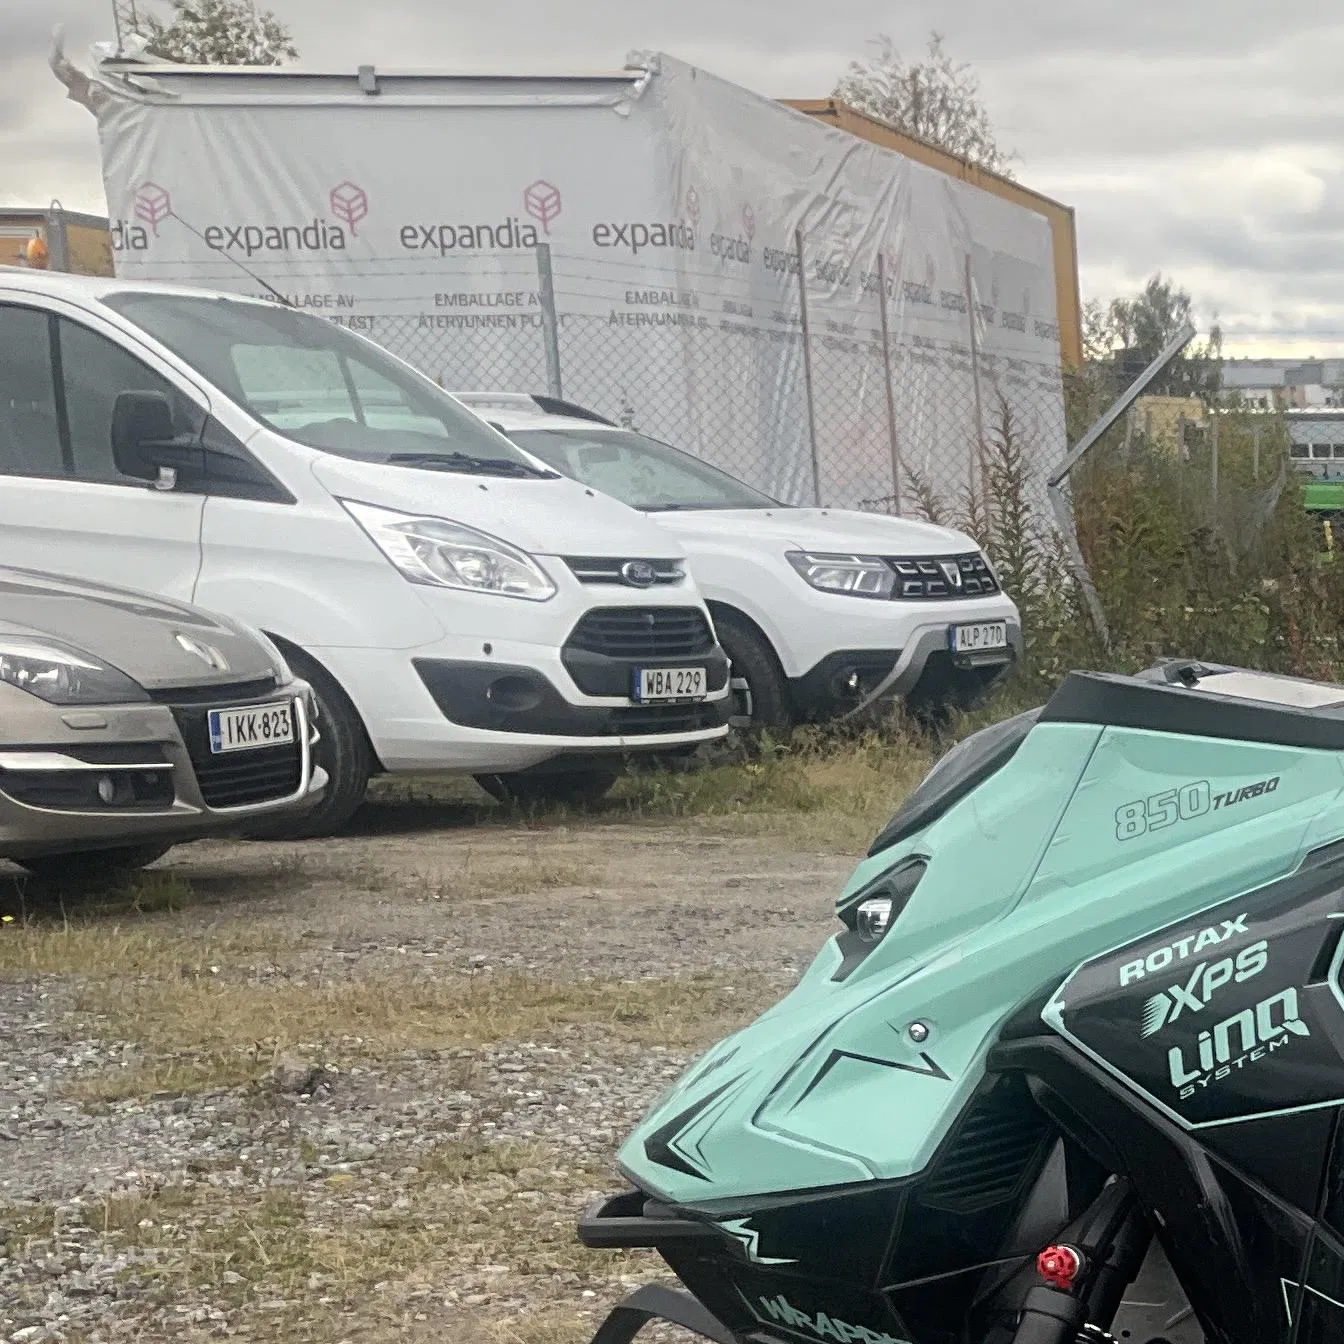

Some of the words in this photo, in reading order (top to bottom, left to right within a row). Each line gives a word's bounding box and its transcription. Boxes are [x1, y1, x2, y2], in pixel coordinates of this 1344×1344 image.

[204, 219, 346, 257] expandia
[400, 217, 539, 257] expandia
[434, 292, 525, 307] EMBALLAGE
[646, 671, 672, 694] WBA
[676, 671, 701, 694] 229
[227, 709, 290, 744] IKK-823
[1114, 779, 1211, 842] 850
[1213, 776, 1282, 811] TURBO
[1119, 912, 1249, 987] ROTAX
[1167, 939, 1268, 1024] XPS
[1179, 1034, 1289, 1100] SYSTEM
